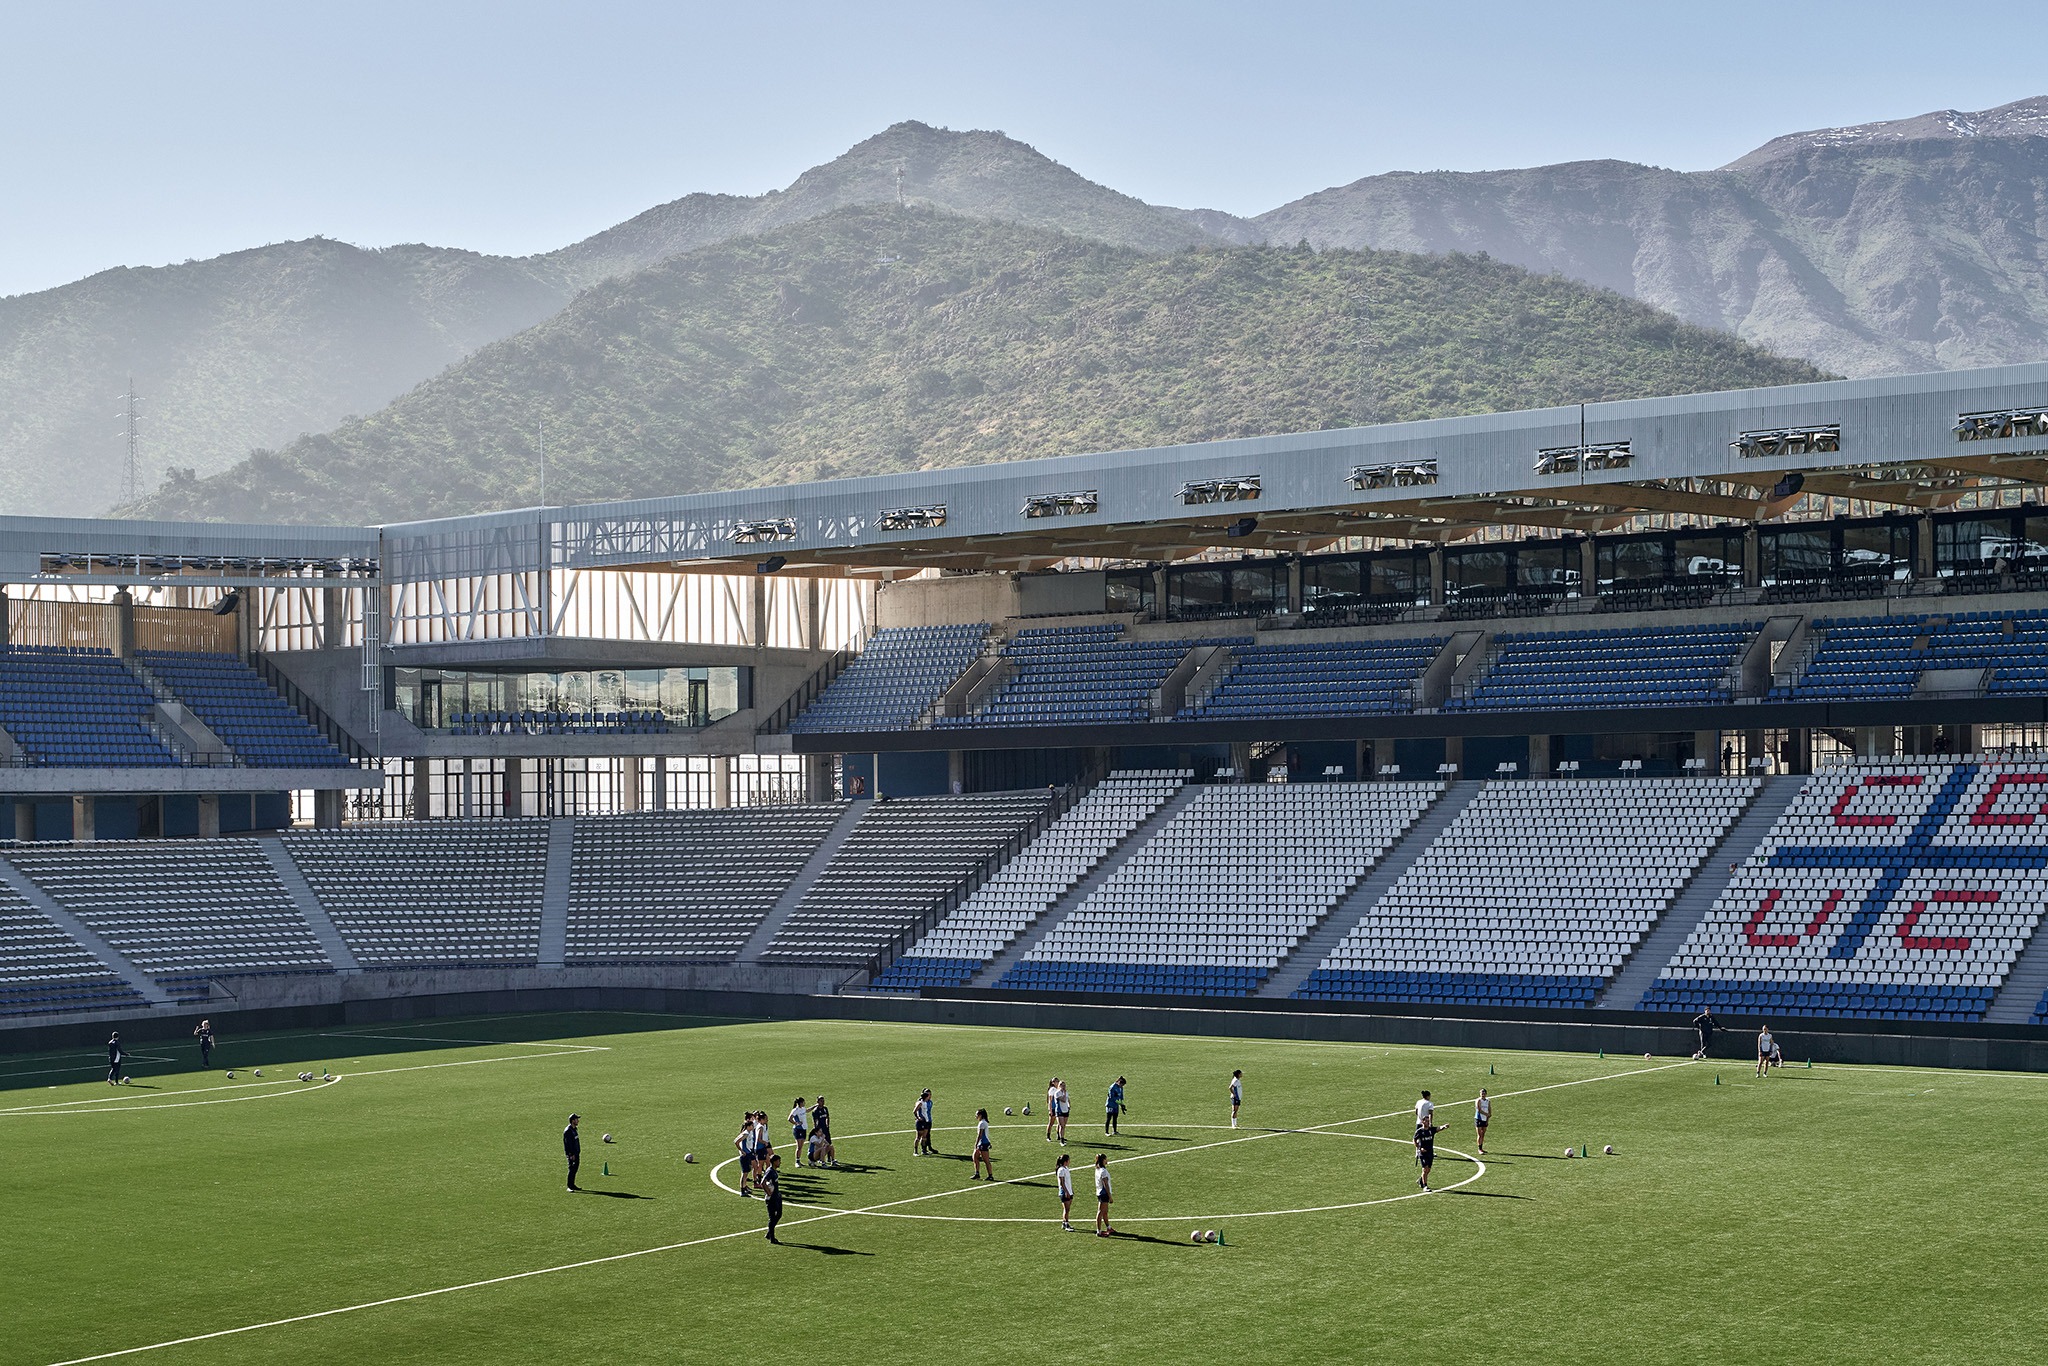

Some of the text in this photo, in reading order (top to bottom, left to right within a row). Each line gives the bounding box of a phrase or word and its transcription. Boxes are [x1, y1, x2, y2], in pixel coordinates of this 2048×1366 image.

[1830, 776, 1923, 826] C
[1743, 889, 1999, 950] U C
